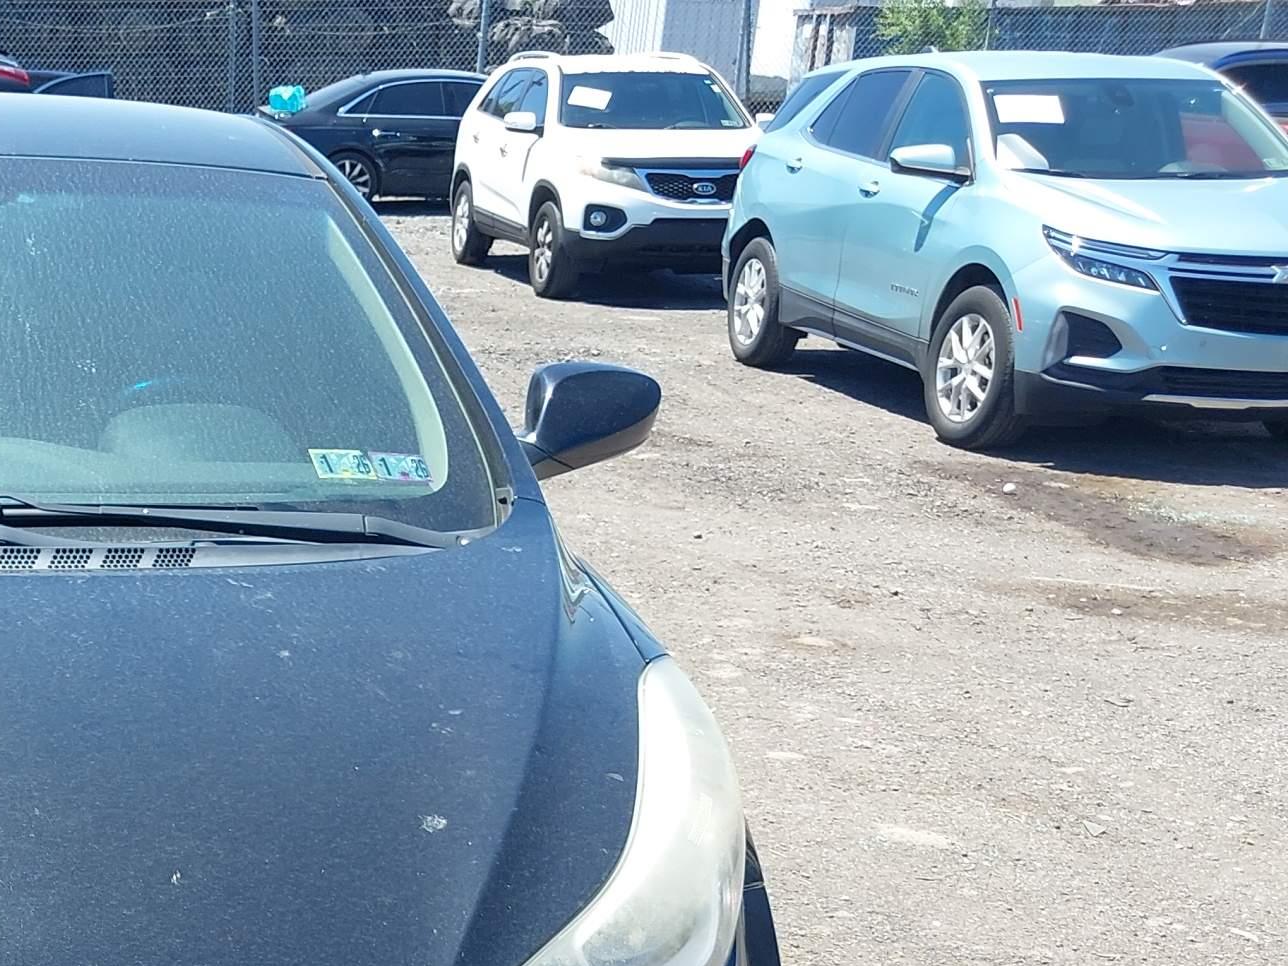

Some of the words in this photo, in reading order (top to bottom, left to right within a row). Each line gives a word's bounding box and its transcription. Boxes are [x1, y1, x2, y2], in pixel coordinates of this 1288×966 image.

[320, 454, 334, 473] 1
[353, 454, 372, 475] 26
[378, 457, 393, 476] 1
